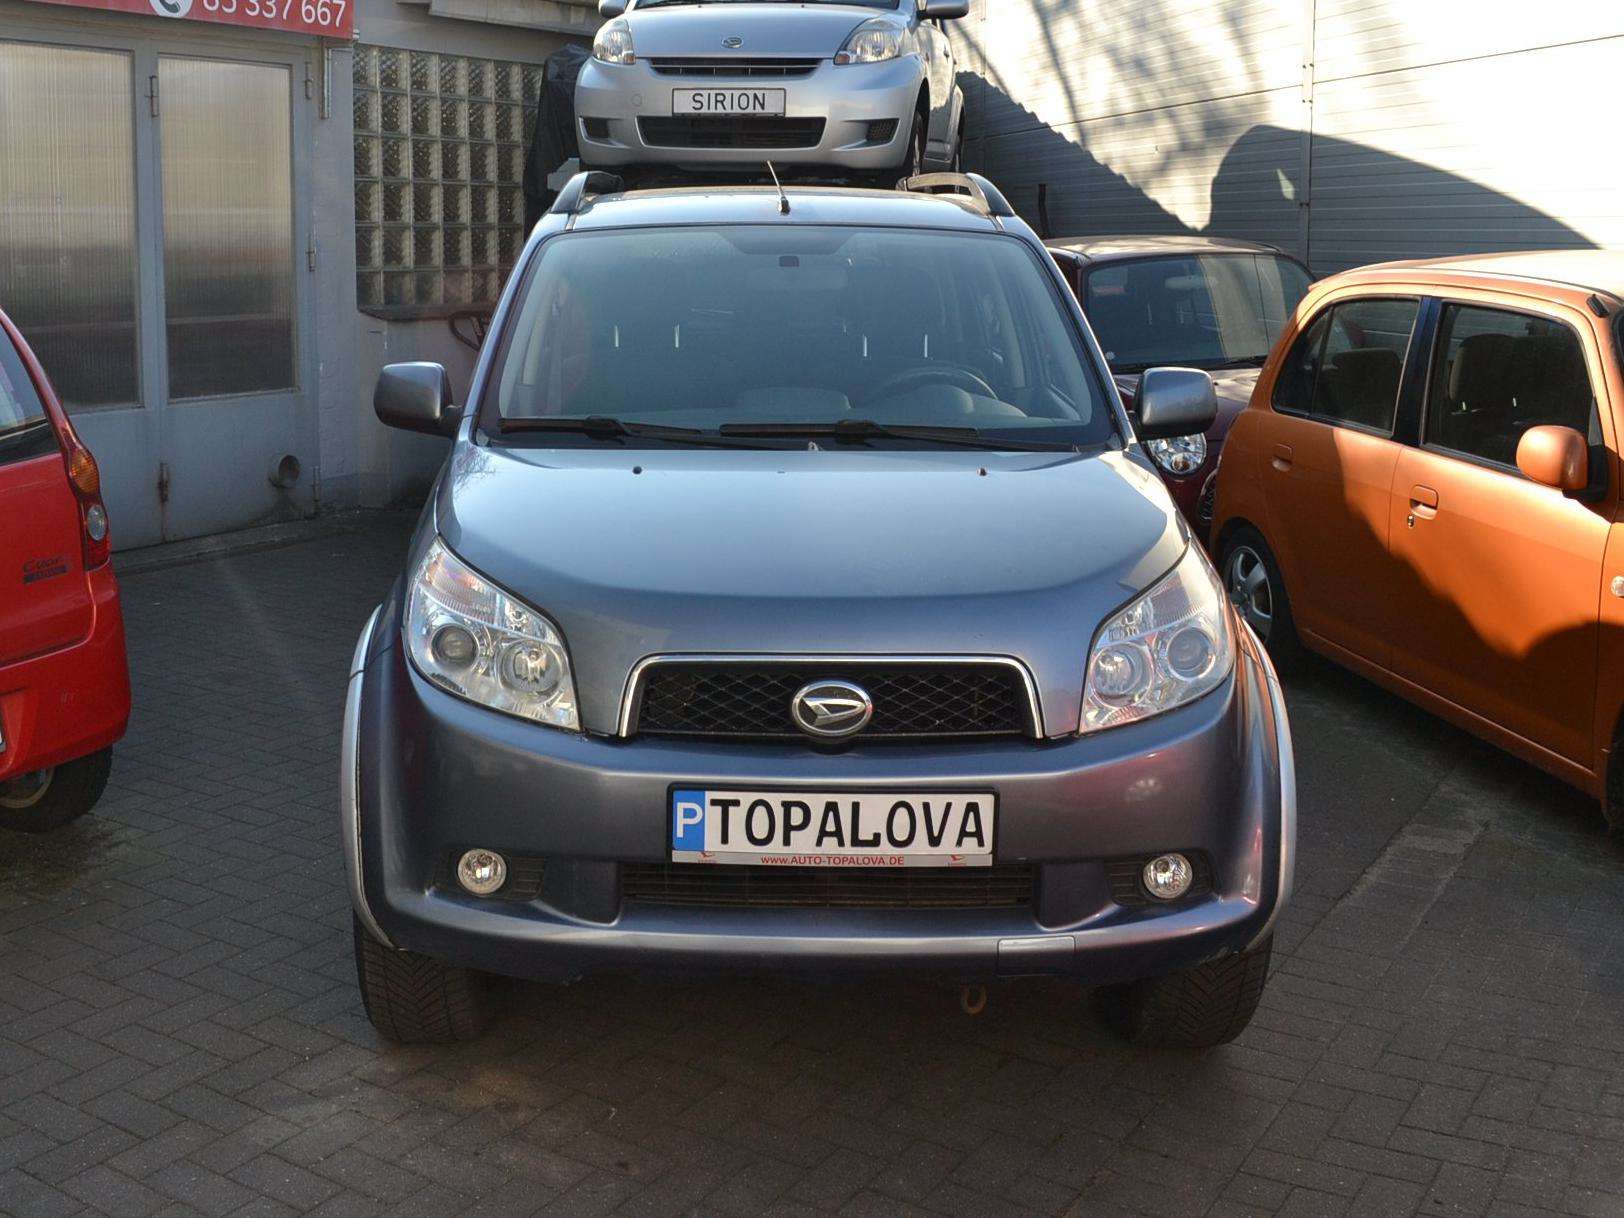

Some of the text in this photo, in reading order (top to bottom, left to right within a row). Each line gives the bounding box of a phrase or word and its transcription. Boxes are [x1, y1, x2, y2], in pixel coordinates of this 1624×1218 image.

[301, 0, 346, 28] 667
[691, 92, 766, 111] SIRION
[675, 798, 986, 848] P TOPALOVA
[760, 855, 905, 866] www.AUTO-TOPALOVA.DE
